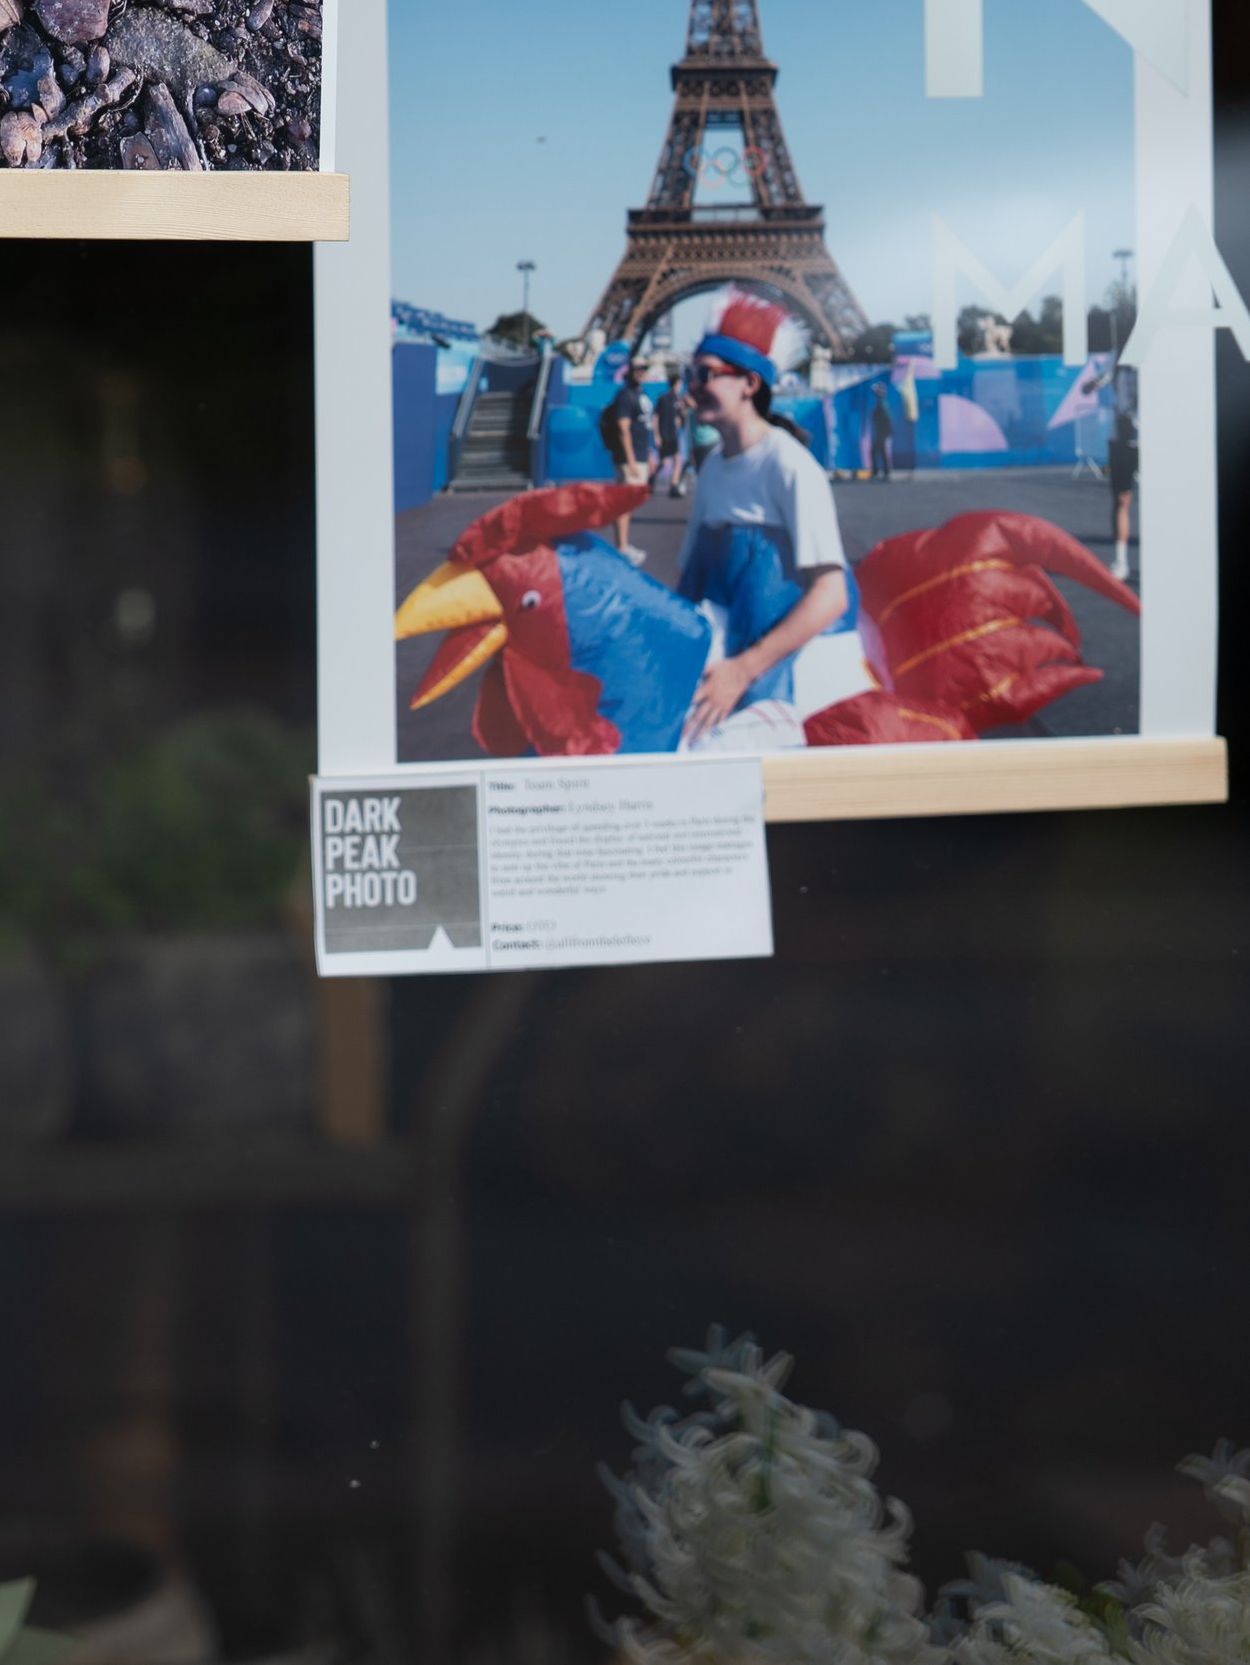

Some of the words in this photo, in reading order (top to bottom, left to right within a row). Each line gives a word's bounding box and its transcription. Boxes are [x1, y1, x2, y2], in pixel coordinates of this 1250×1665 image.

[324, 797, 402, 834] DARK
[325, 834, 401, 871] PEAK
[325, 870, 418, 909] PHOTO
